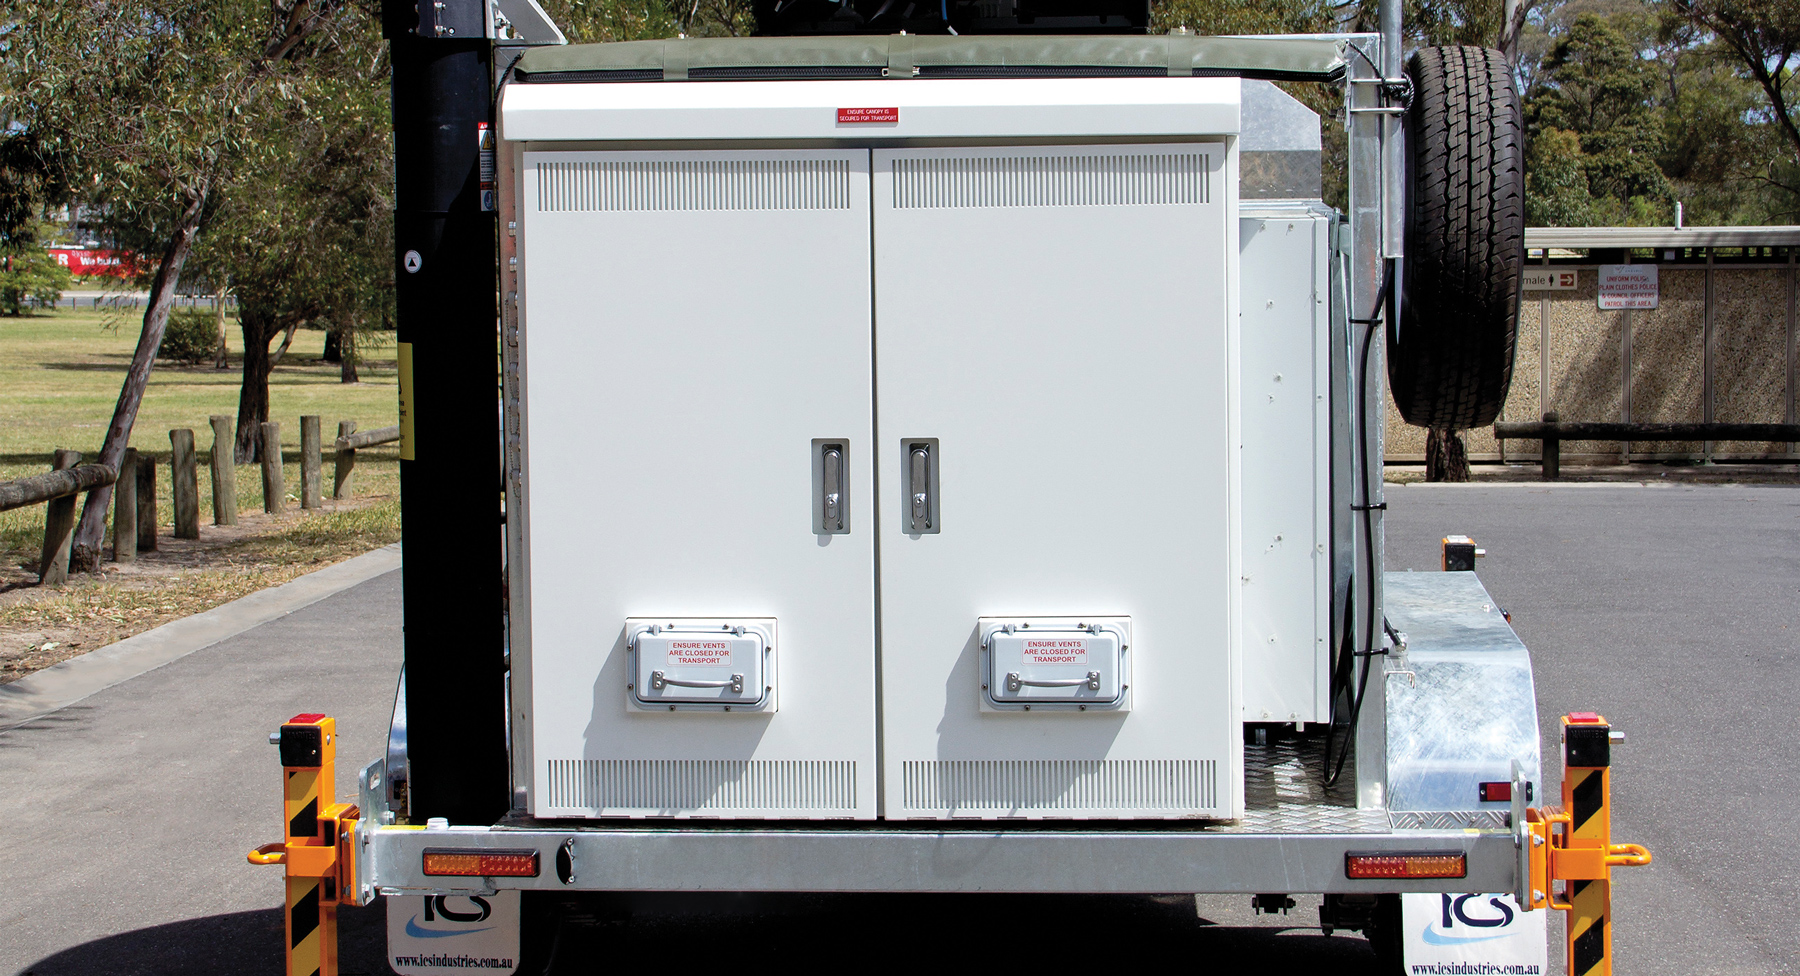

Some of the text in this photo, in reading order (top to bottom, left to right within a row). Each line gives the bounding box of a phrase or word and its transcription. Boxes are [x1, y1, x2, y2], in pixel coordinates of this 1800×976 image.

[1441, 892, 1514, 928] ICS
[395, 953, 513, 968] www.icsindustries.com.au
[1412, 961, 1539, 975] www.icsindustries.com.au
